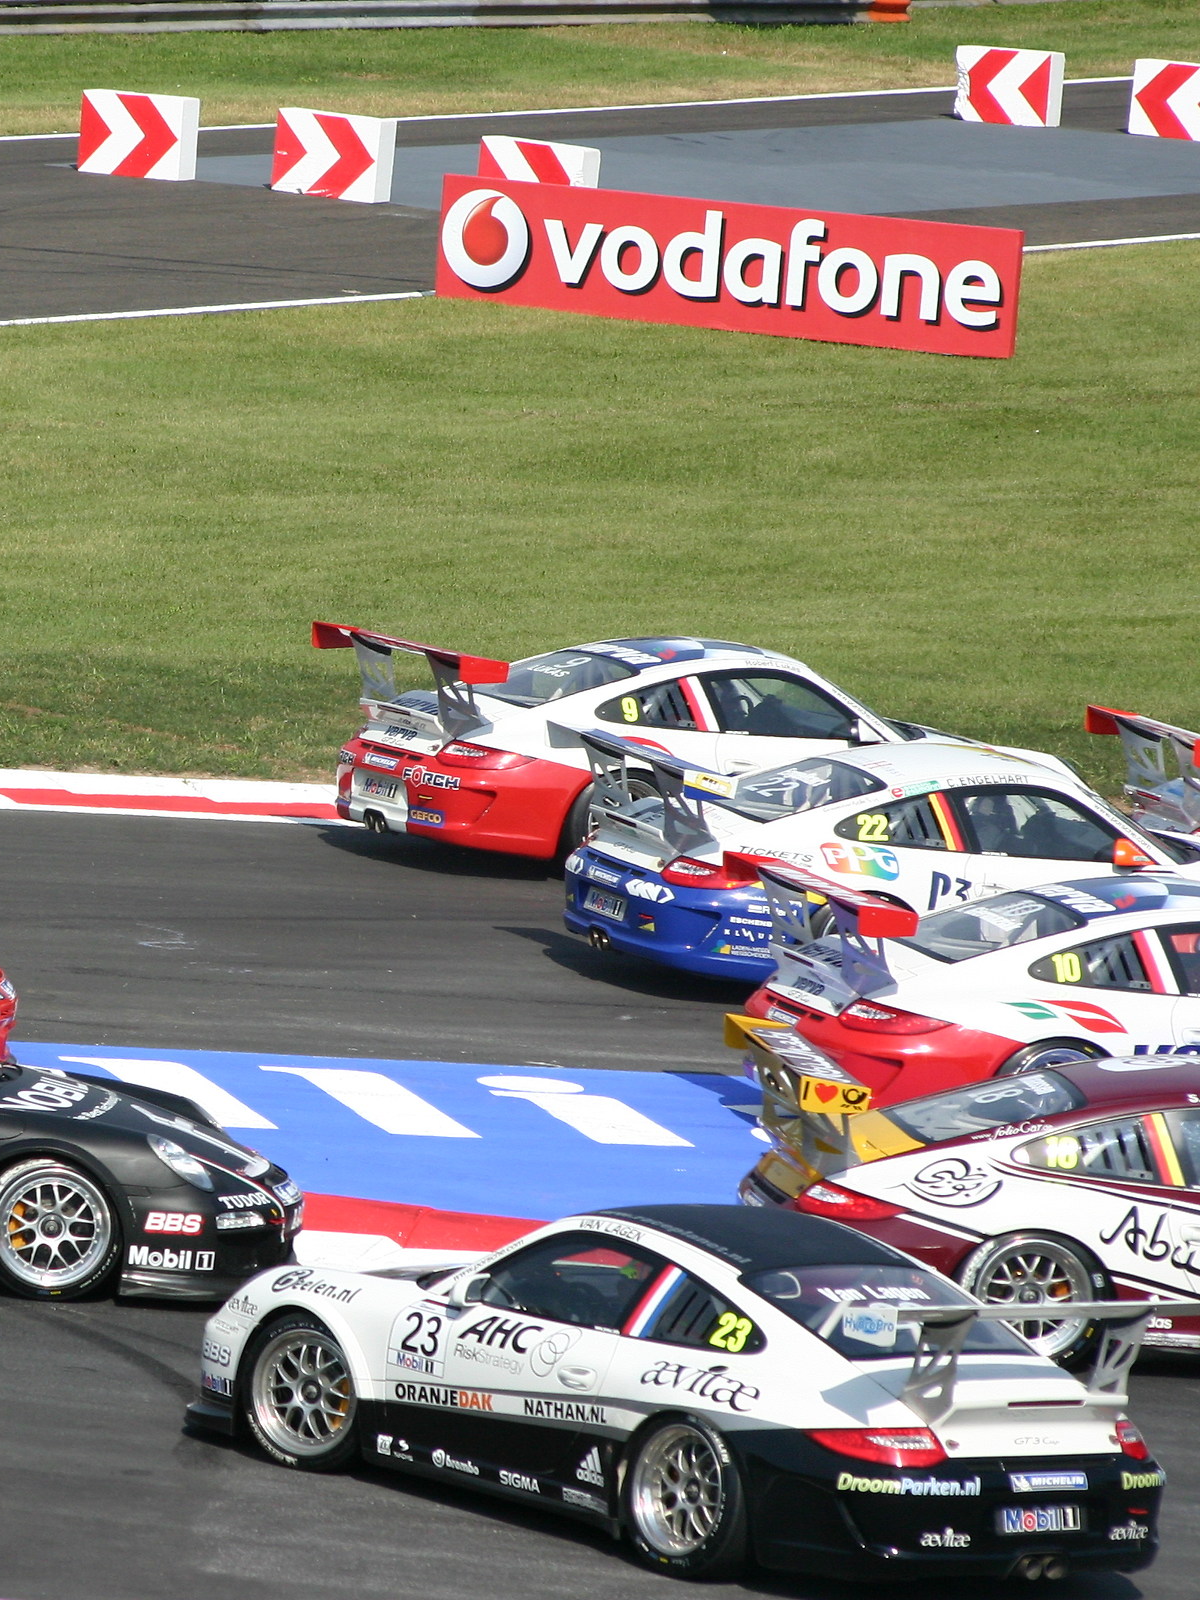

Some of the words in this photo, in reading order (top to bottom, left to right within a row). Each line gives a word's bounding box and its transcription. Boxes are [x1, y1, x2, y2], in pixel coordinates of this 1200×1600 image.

[543, 209, 1001, 328] vodafone
[621, 697, 639, 723] 9
[411, 809, 442, 824] GEFCO
[857, 814, 888, 841] 22
[740, 845, 814, 863] TICKETS
[823, 846, 898, 877] PPG
[1052, 952, 1081, 983] 10
[803, 1081, 810, 1100] I
[1046, 1136, 1078, 1169] 18
[218, 1192, 270, 1209] TUDOR
[145, 1212, 202, 1234] BBS
[579, 1219, 601, 1230] VAN
[604, 1222, 646, 1242] LAGEN
[128, 1246, 191, 1270] Mobil
[197, 1252, 213, 1269] 1
[817, 1287, 867, 1302] Van
[401, 1312, 442, 1357] 23
[458, 1316, 543, 1354] AHC
[709, 1311, 753, 1352] 23
[845, 1316, 895, 1334] HydroPro
[397, 1352, 423, 1371] Mobil
[453, 1343, 525, 1376] RiskStrategy
[395, 1383, 494, 1411] ORANJEDAK
[524, 1399, 607, 1424] NATHAN.NL
[446, 1457, 480, 1476] brembo
[576, 1468, 605, 1488] adidas
[500, 1470, 540, 1493] SIGMA
[836, 1472, 981, 1497] DroomParken.nl
[1031, 1476, 1084, 1486] MICHELIN
[1003, 1507, 1060, 1533] Mobil
[1062, 1507, 1079, 1530] 1
